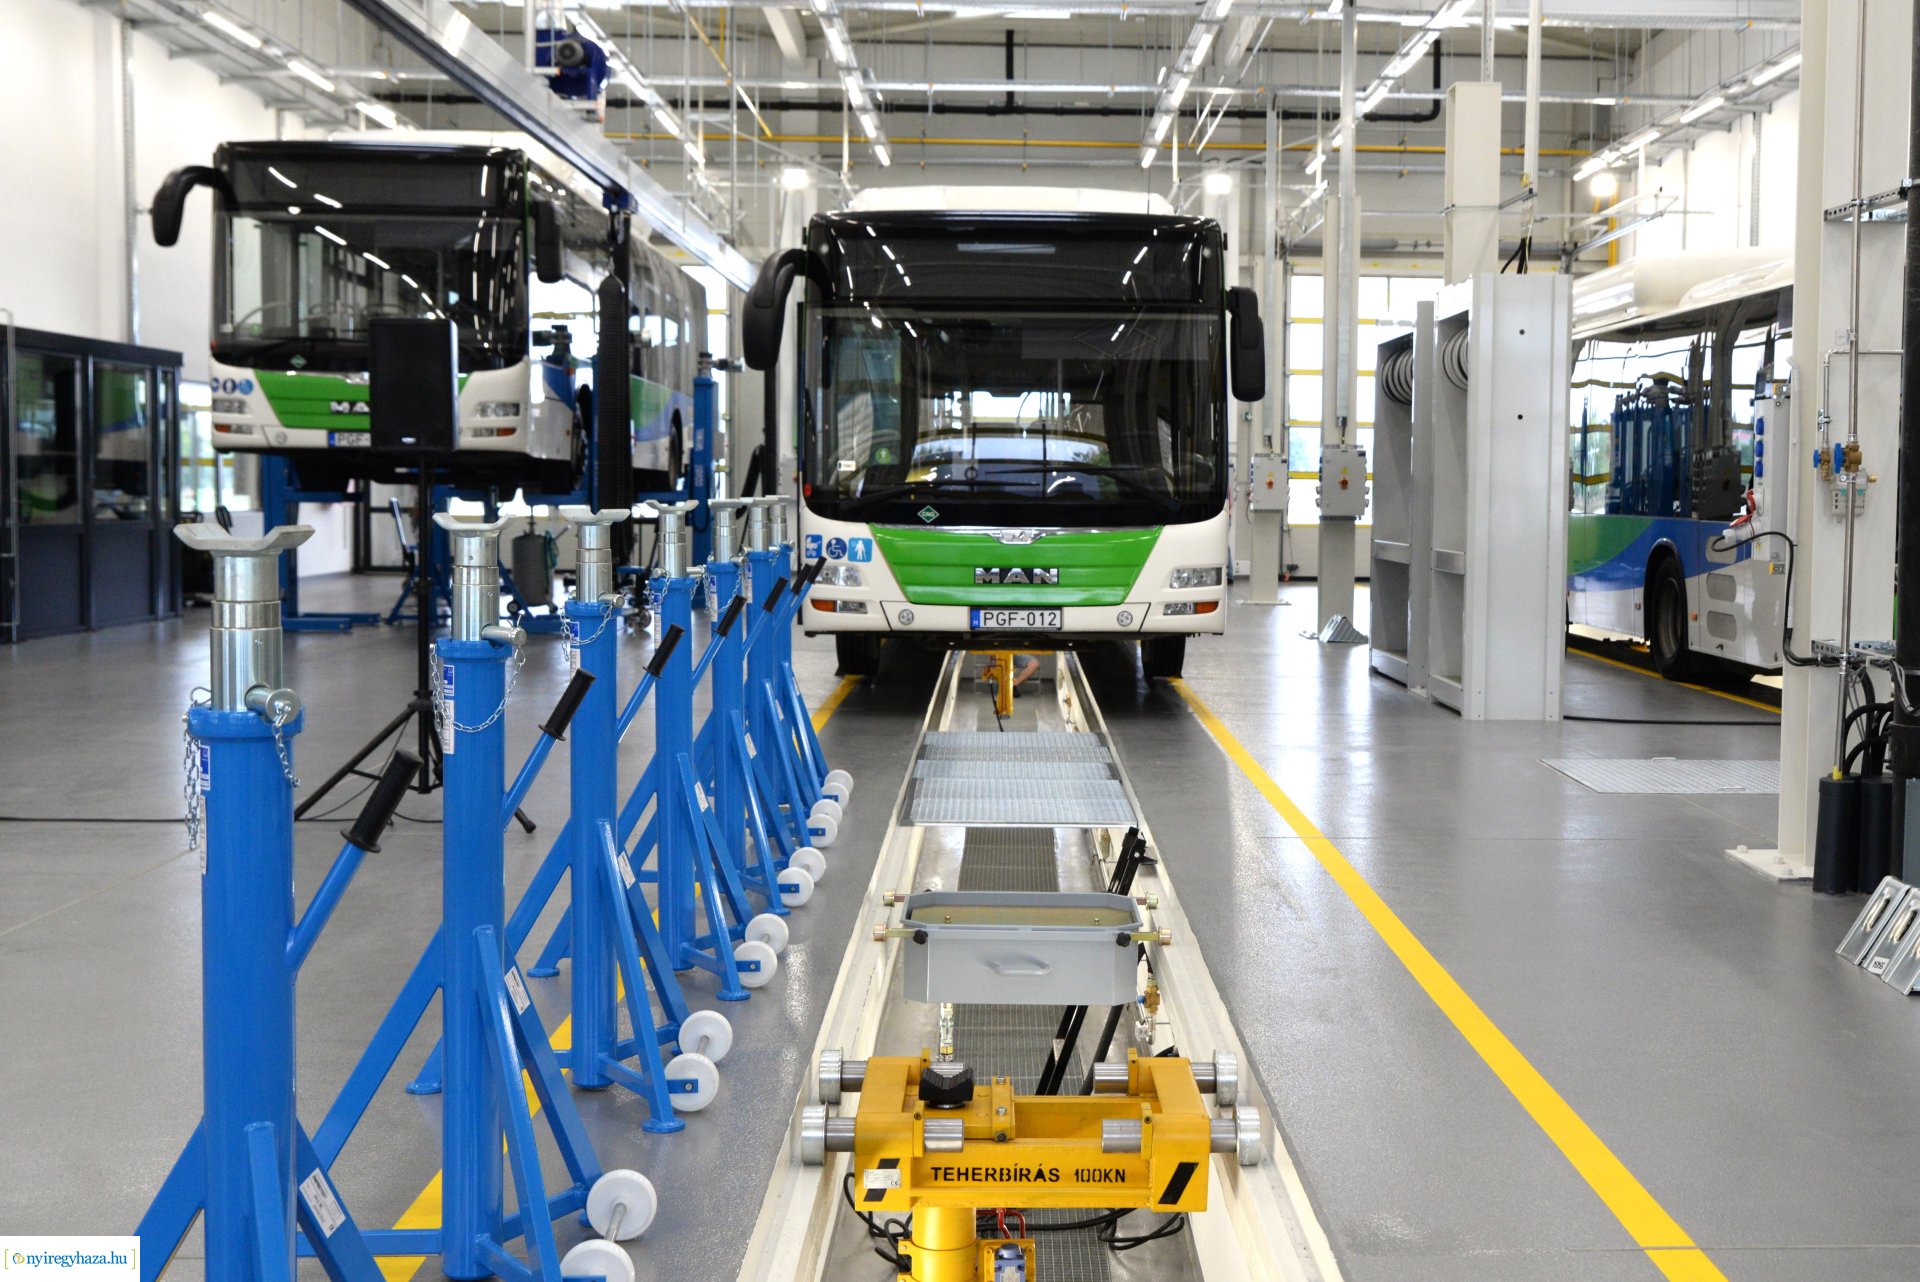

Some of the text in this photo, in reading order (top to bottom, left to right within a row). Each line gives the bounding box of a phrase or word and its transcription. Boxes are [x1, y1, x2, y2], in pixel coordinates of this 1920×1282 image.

[330, 401, 370, 413] MA
[975, 568, 1058, 583] MAN
[983, 612, 1057, 626] PGF-012
[931, 1163, 1126, 1183] TEHERBÍRÁS 100KN
